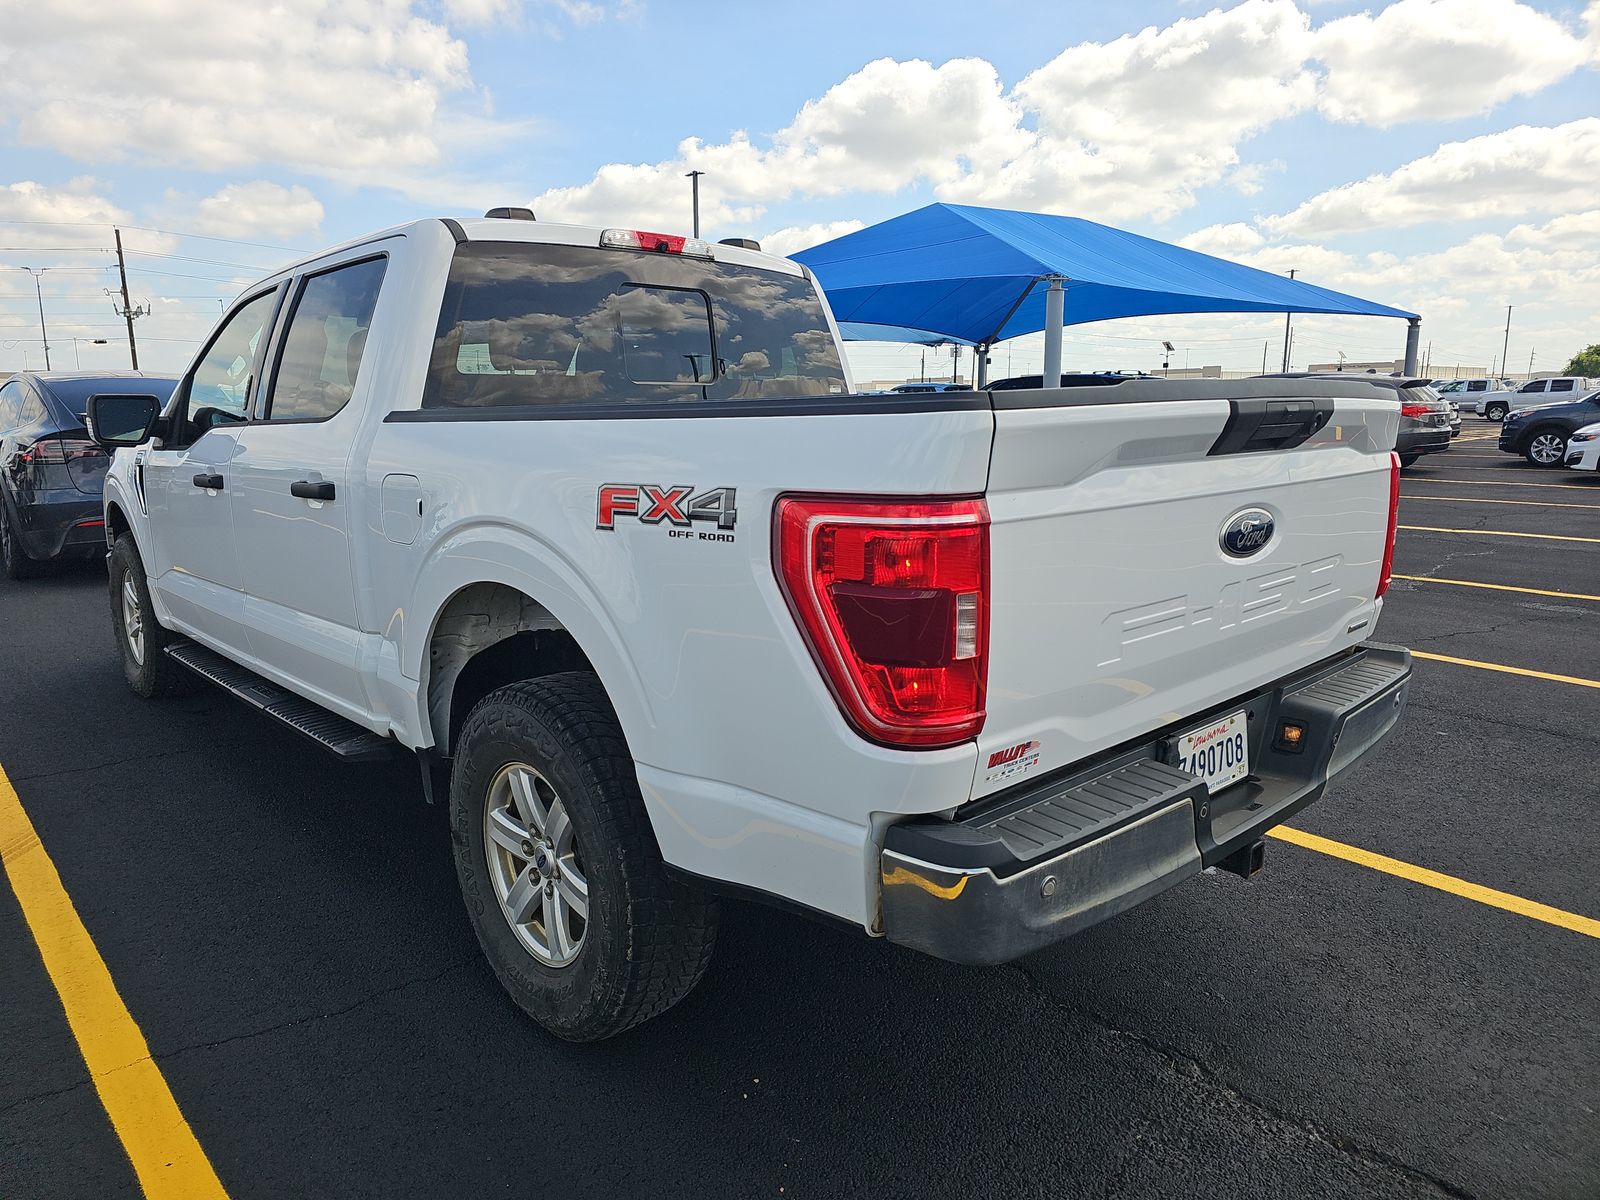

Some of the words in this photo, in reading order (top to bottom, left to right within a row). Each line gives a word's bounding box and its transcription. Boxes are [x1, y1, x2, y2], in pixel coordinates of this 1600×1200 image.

[596, 483, 737, 531] FX4
[668, 530, 694, 539] OFF
[698, 532, 735, 543] ROAD
[1236, 519, 1269, 549] Ford
[1097, 553, 1344, 667] F-150
[987, 741, 1032, 769] VALLEY
